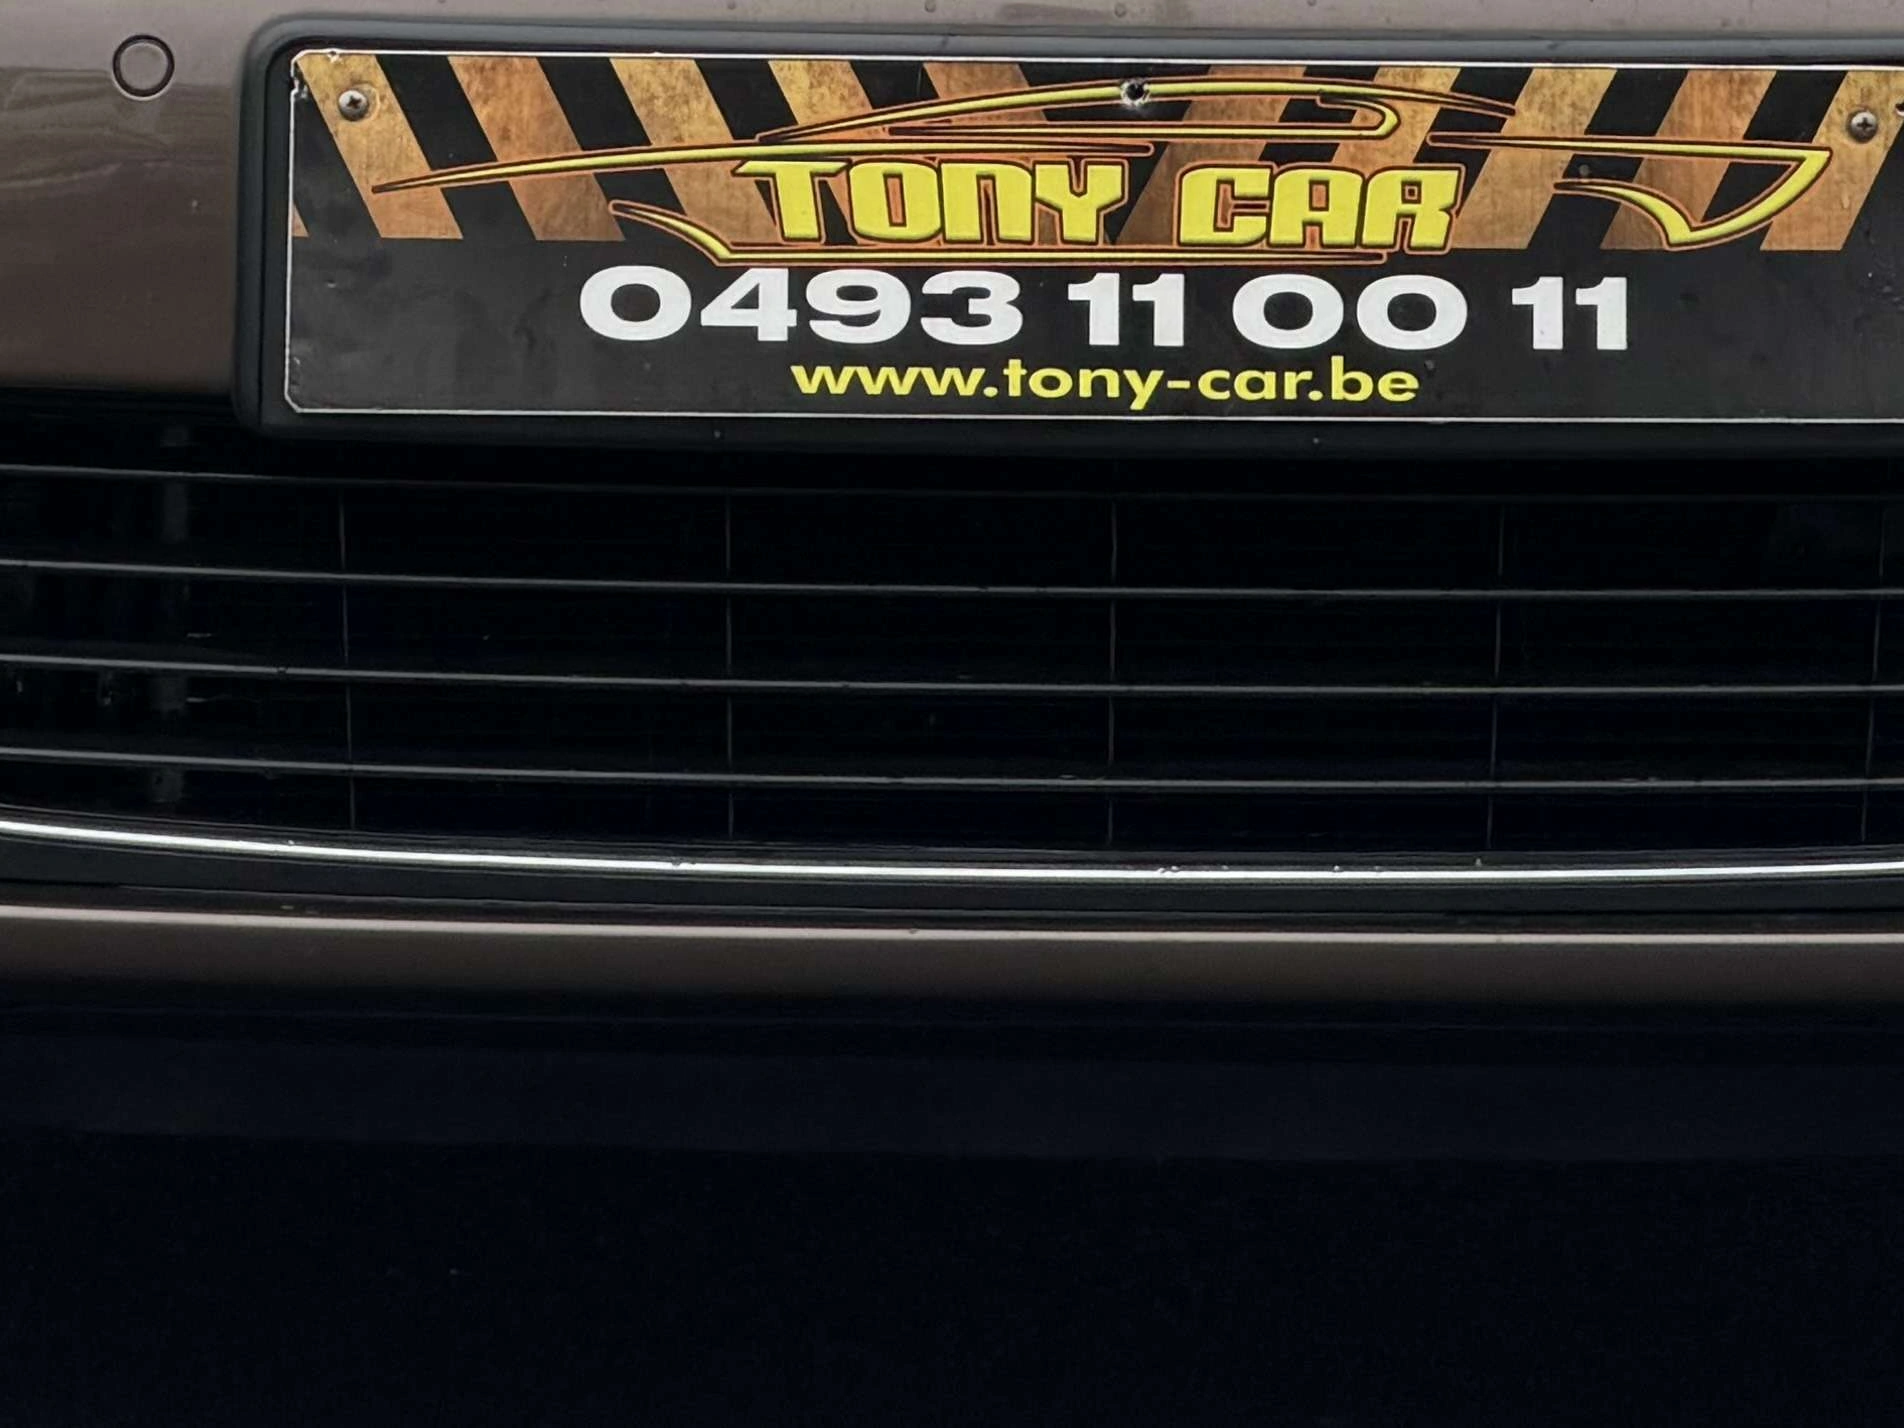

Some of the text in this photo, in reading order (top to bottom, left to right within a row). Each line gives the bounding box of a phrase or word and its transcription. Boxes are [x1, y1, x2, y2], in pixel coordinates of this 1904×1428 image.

[734, 158, 1461, 248] TONY CAR
[578, 264, 1629, 352] 0493 11 00 11
[789, 356, 1418, 412] www.tony-car.be
